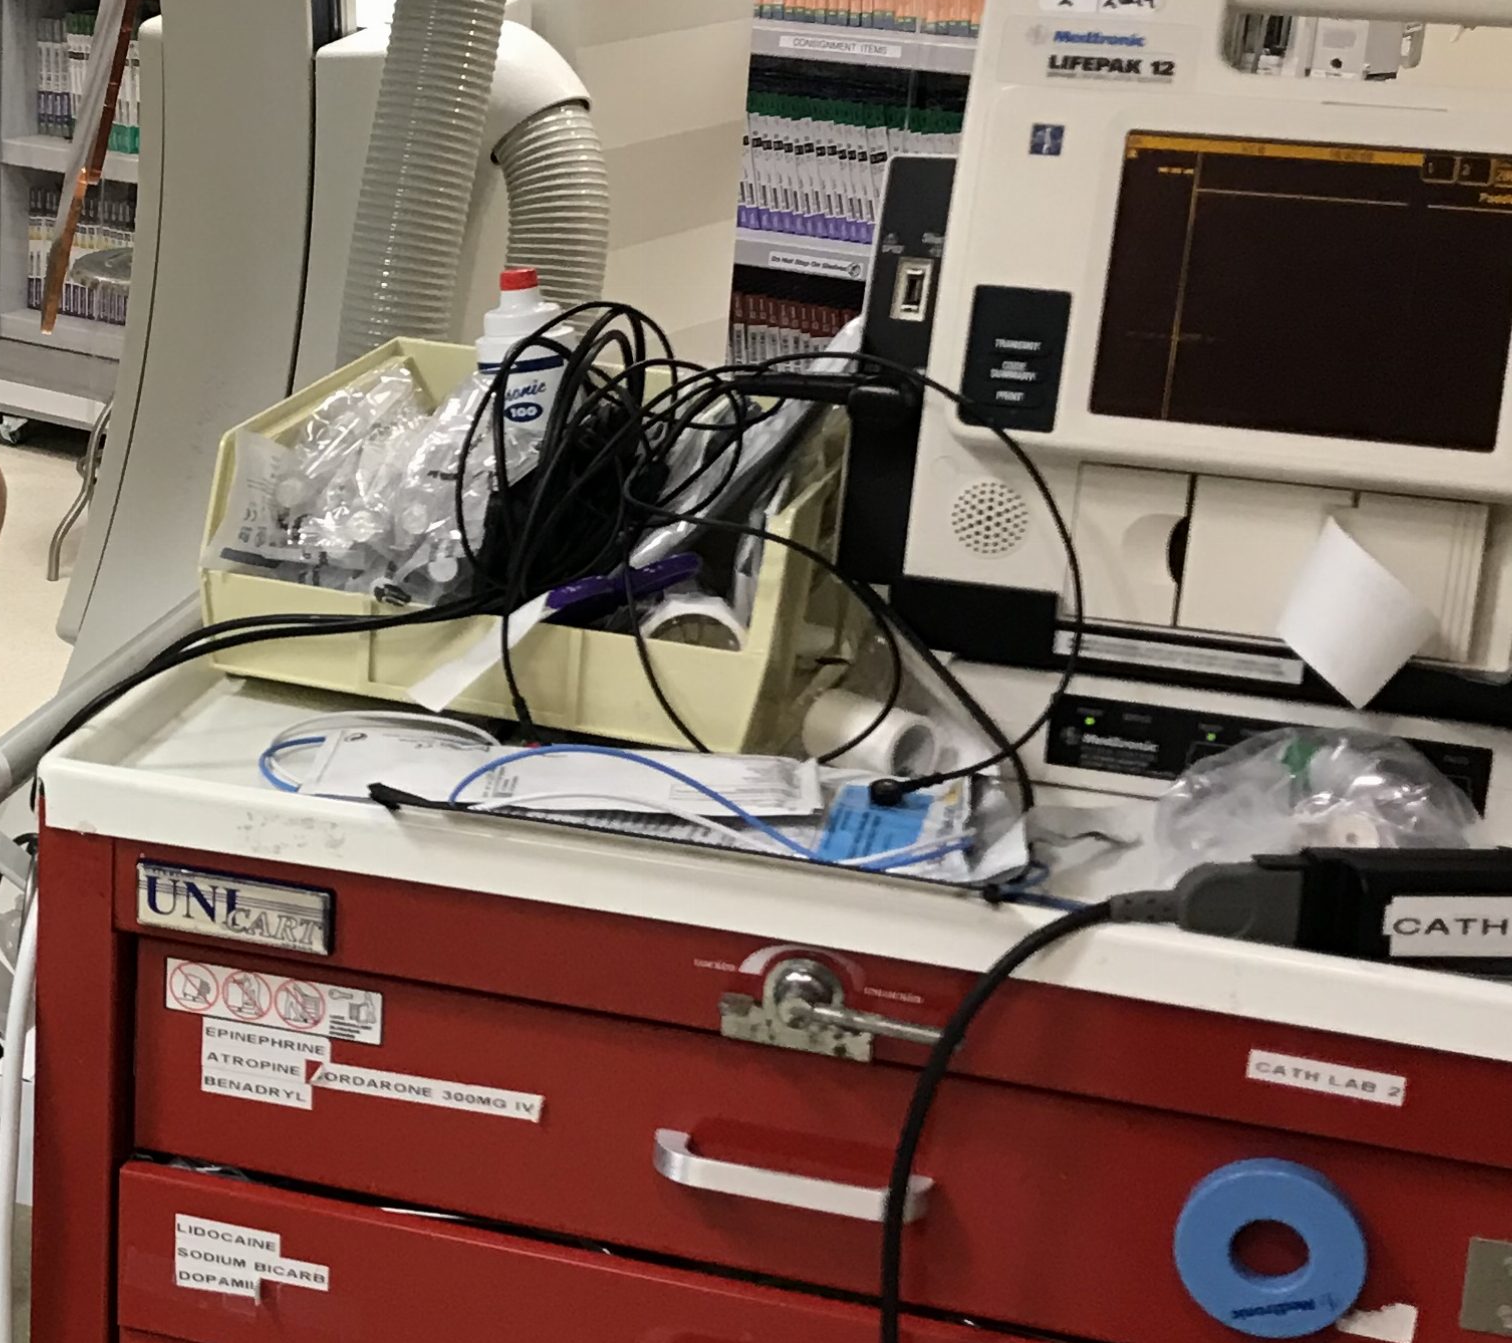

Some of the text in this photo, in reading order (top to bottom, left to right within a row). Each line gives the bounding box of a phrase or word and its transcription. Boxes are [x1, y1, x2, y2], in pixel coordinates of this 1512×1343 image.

[793, 37, 888, 55] CONSIGNMENT ITEMS
[1054, 30, 1147, 47] Medtronic
[1048, 54, 1176, 76] LIFEPAK 12
[505, 379, 547, 402] sonic
[510, 405, 537, 418] 100
[1392, 917, 1508, 936] CATH
[205, 1026, 327, 1056] EPINEPHRINE
[206, 1051, 302, 1077] ATROPINE
[203, 1075, 306, 1103] BENADRYL
[1254, 1061, 1402, 1097] CATH LAB 2
[441, 1089, 507, 1110] 300MG
[515, 1100, 536, 1115] IV
[176, 1222, 276, 1253] LIDOCAINE
[177, 1247, 326, 1284] SODIUM BICARB
[178, 1270, 259, 1291] DOPAMI
[1231, 1298, 1316, 1320] Medtronic
